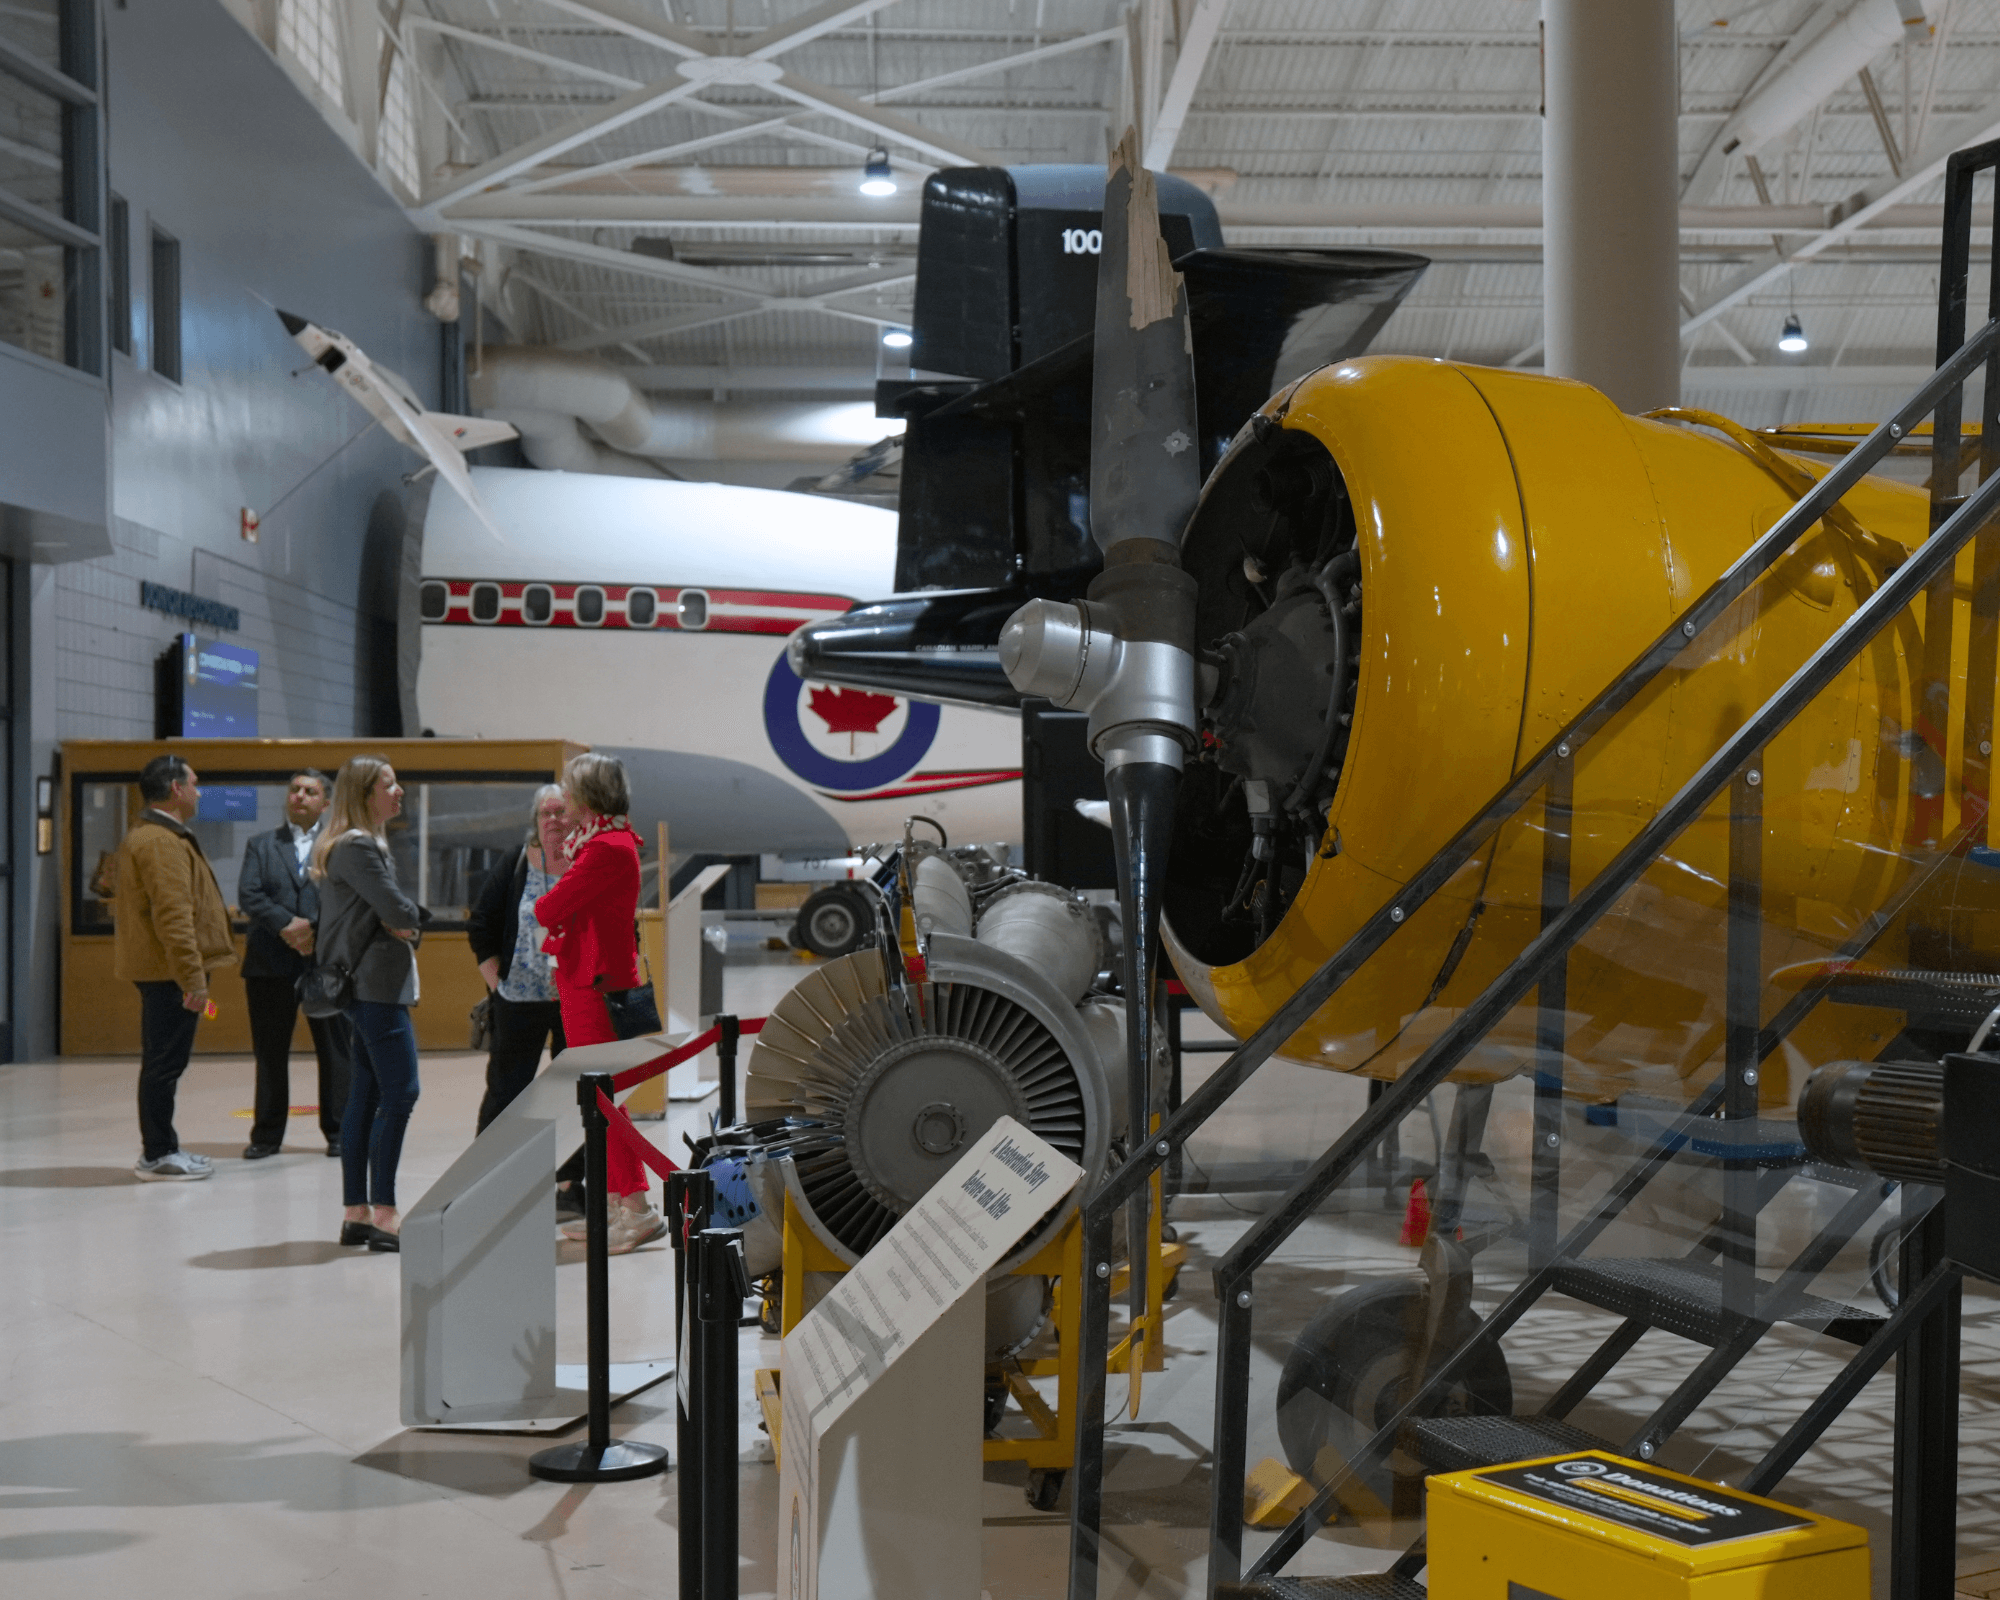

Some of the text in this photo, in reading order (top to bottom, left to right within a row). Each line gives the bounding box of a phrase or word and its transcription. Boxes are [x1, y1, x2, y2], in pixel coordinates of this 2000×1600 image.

[1061, 228, 1102, 255] 100
[915, 644, 957, 653] CANADIAN
[989, 1135, 1051, 1195] A Restoration Story
[960, 1169, 1012, 1221] Before and After
[1601, 1472, 1743, 1517] Donations
